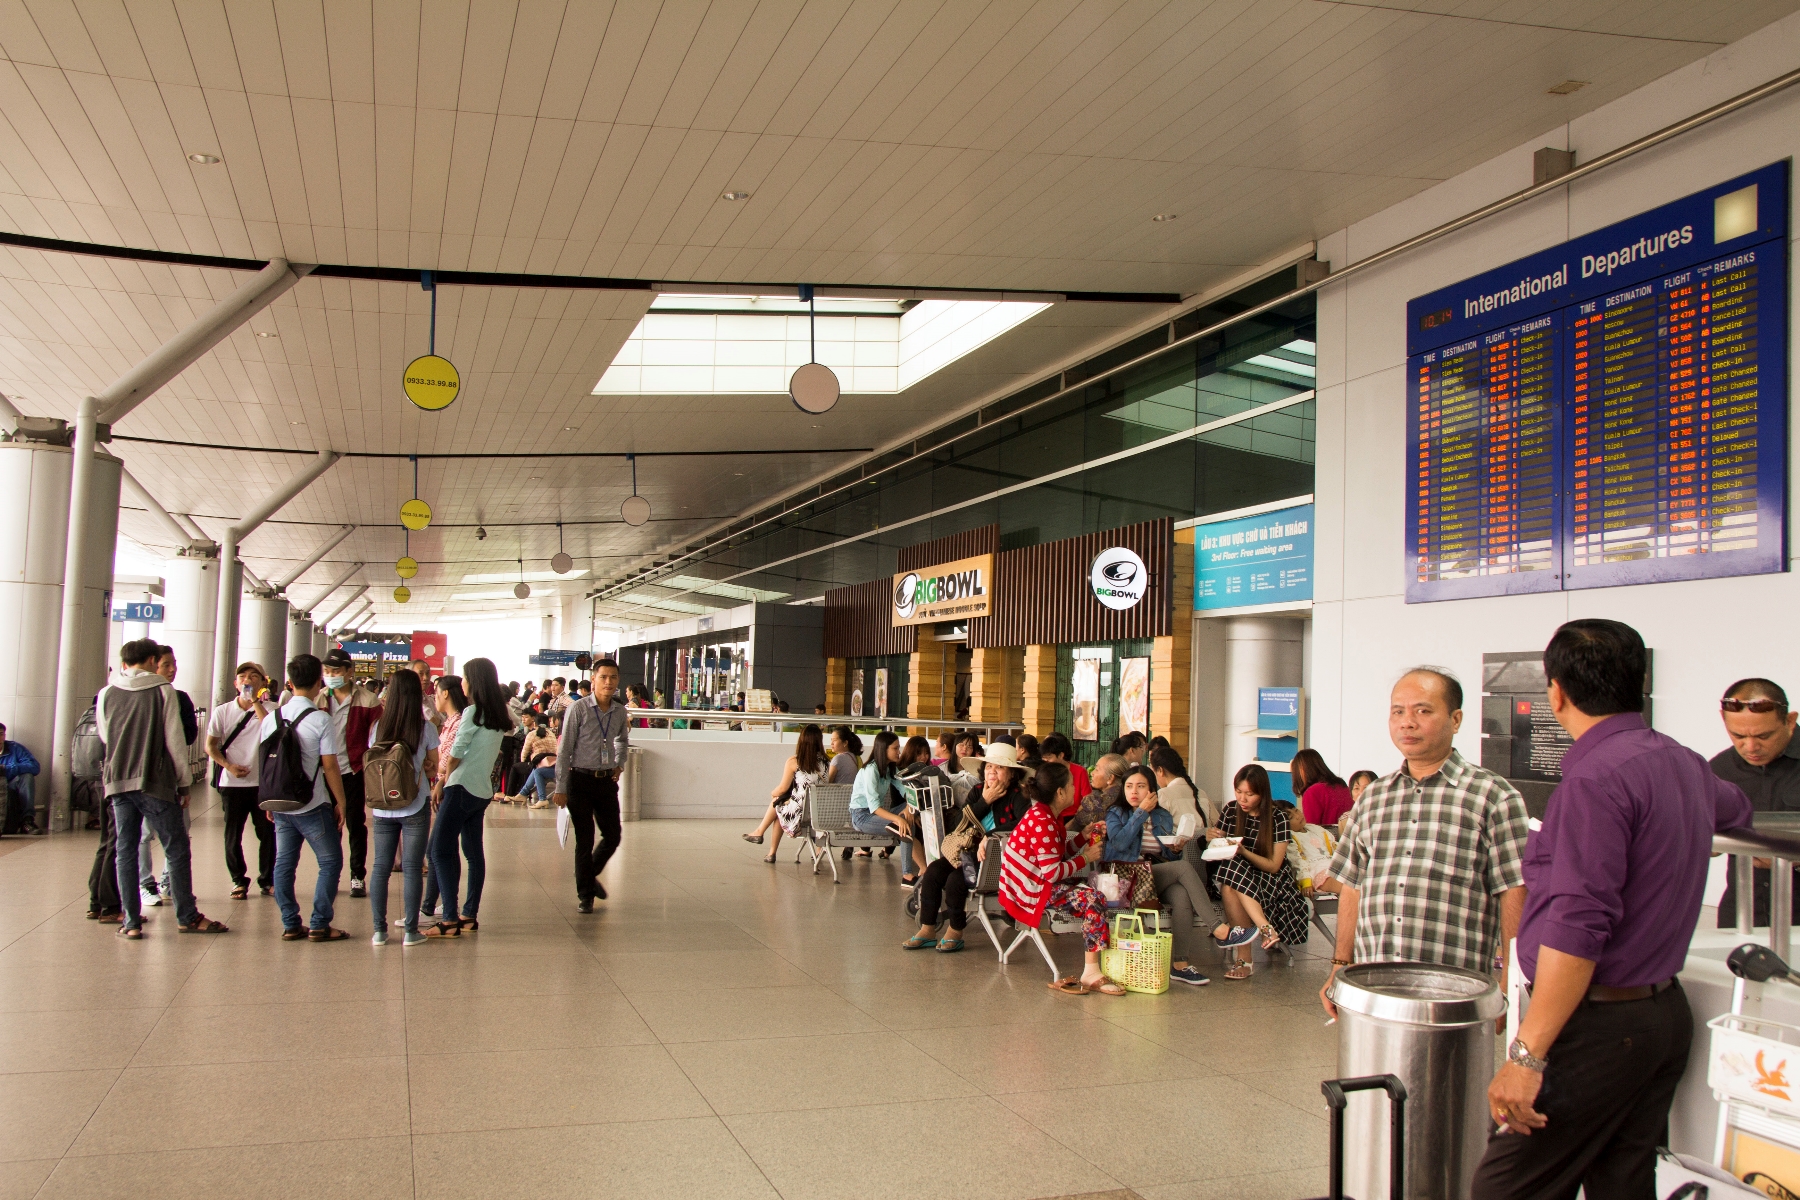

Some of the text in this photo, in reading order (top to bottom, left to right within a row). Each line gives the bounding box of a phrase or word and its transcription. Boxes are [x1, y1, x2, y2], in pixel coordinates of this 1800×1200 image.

[1464, 223, 1694, 319] International Departures
[1711, 275, 1727, 286] Last
[1730, 269, 1746, 280] Call
[1580, 251, 1755, 315] TIME DESTINATION FLIGHT Check REMARKS
[1680, 299, 1688, 307] 61
[1711, 287, 1727, 298] Last
[1730, 281, 1746, 293] Call
[1711, 295, 1742, 310] Boarding
[1711, 306, 1746, 322] Cancelled
[1711, 319, 1742, 334] Boarding
[1423, 352, 1435, 364] TIME
[1442, 339, 1476, 358] DESTINATION
[1485, 331, 1504, 344] FLIGHT
[1521, 316, 1550, 333] REMARKS
[1711, 332, 1742, 346] Boarding
[1711, 348, 1727, 358] Last
[1730, 343, 1746, 354] Call
[1711, 356, 1742, 370] Check-in
[1711, 372, 1727, 382] Gate
[1730, 365, 1758, 378] Changed
[406, 377, 457, 388] 0933.33.99.88
[1711, 384, 1727, 394] Gate
[1730, 377, 1758, 390] Changed
[1711, 397, 1727, 406] Gate
[1730, 390, 1758, 402] Changed
[1711, 409, 1727, 418] Last
[1730, 402, 1758, 415] Check-i
[1711, 421, 1727, 431] Last
[1730, 415, 1758, 427] Check-i
[1711, 431, 1738, 443] Delayed
[1711, 445, 1727, 455] Last
[1730, 440, 1758, 451] Check-i
[1711, 455, 1742, 467] Check-in
[1711, 467, 1742, 479] Check-in
[1711, 480, 1742, 491] Check-in
[1212, 539, 1218, 549] 3:
[1219, 536, 1230, 548] KHU
[1232, 532, 1244, 546] VỰC
[1246, 527, 1258, 543] CHỜ
[1260, 527, 1268, 541] VÀ
[1284, 521, 1308, 536] KHÁCH
[1211, 543, 1293, 562] 3rd Floor: Free waiting area
[916, 570, 986, 604] BIGBOWL
[1096, 588, 1139, 600] BIGBOWL
[135, 605, 154, 618] 10
[348, 650, 409, 661] mino's Pizza
